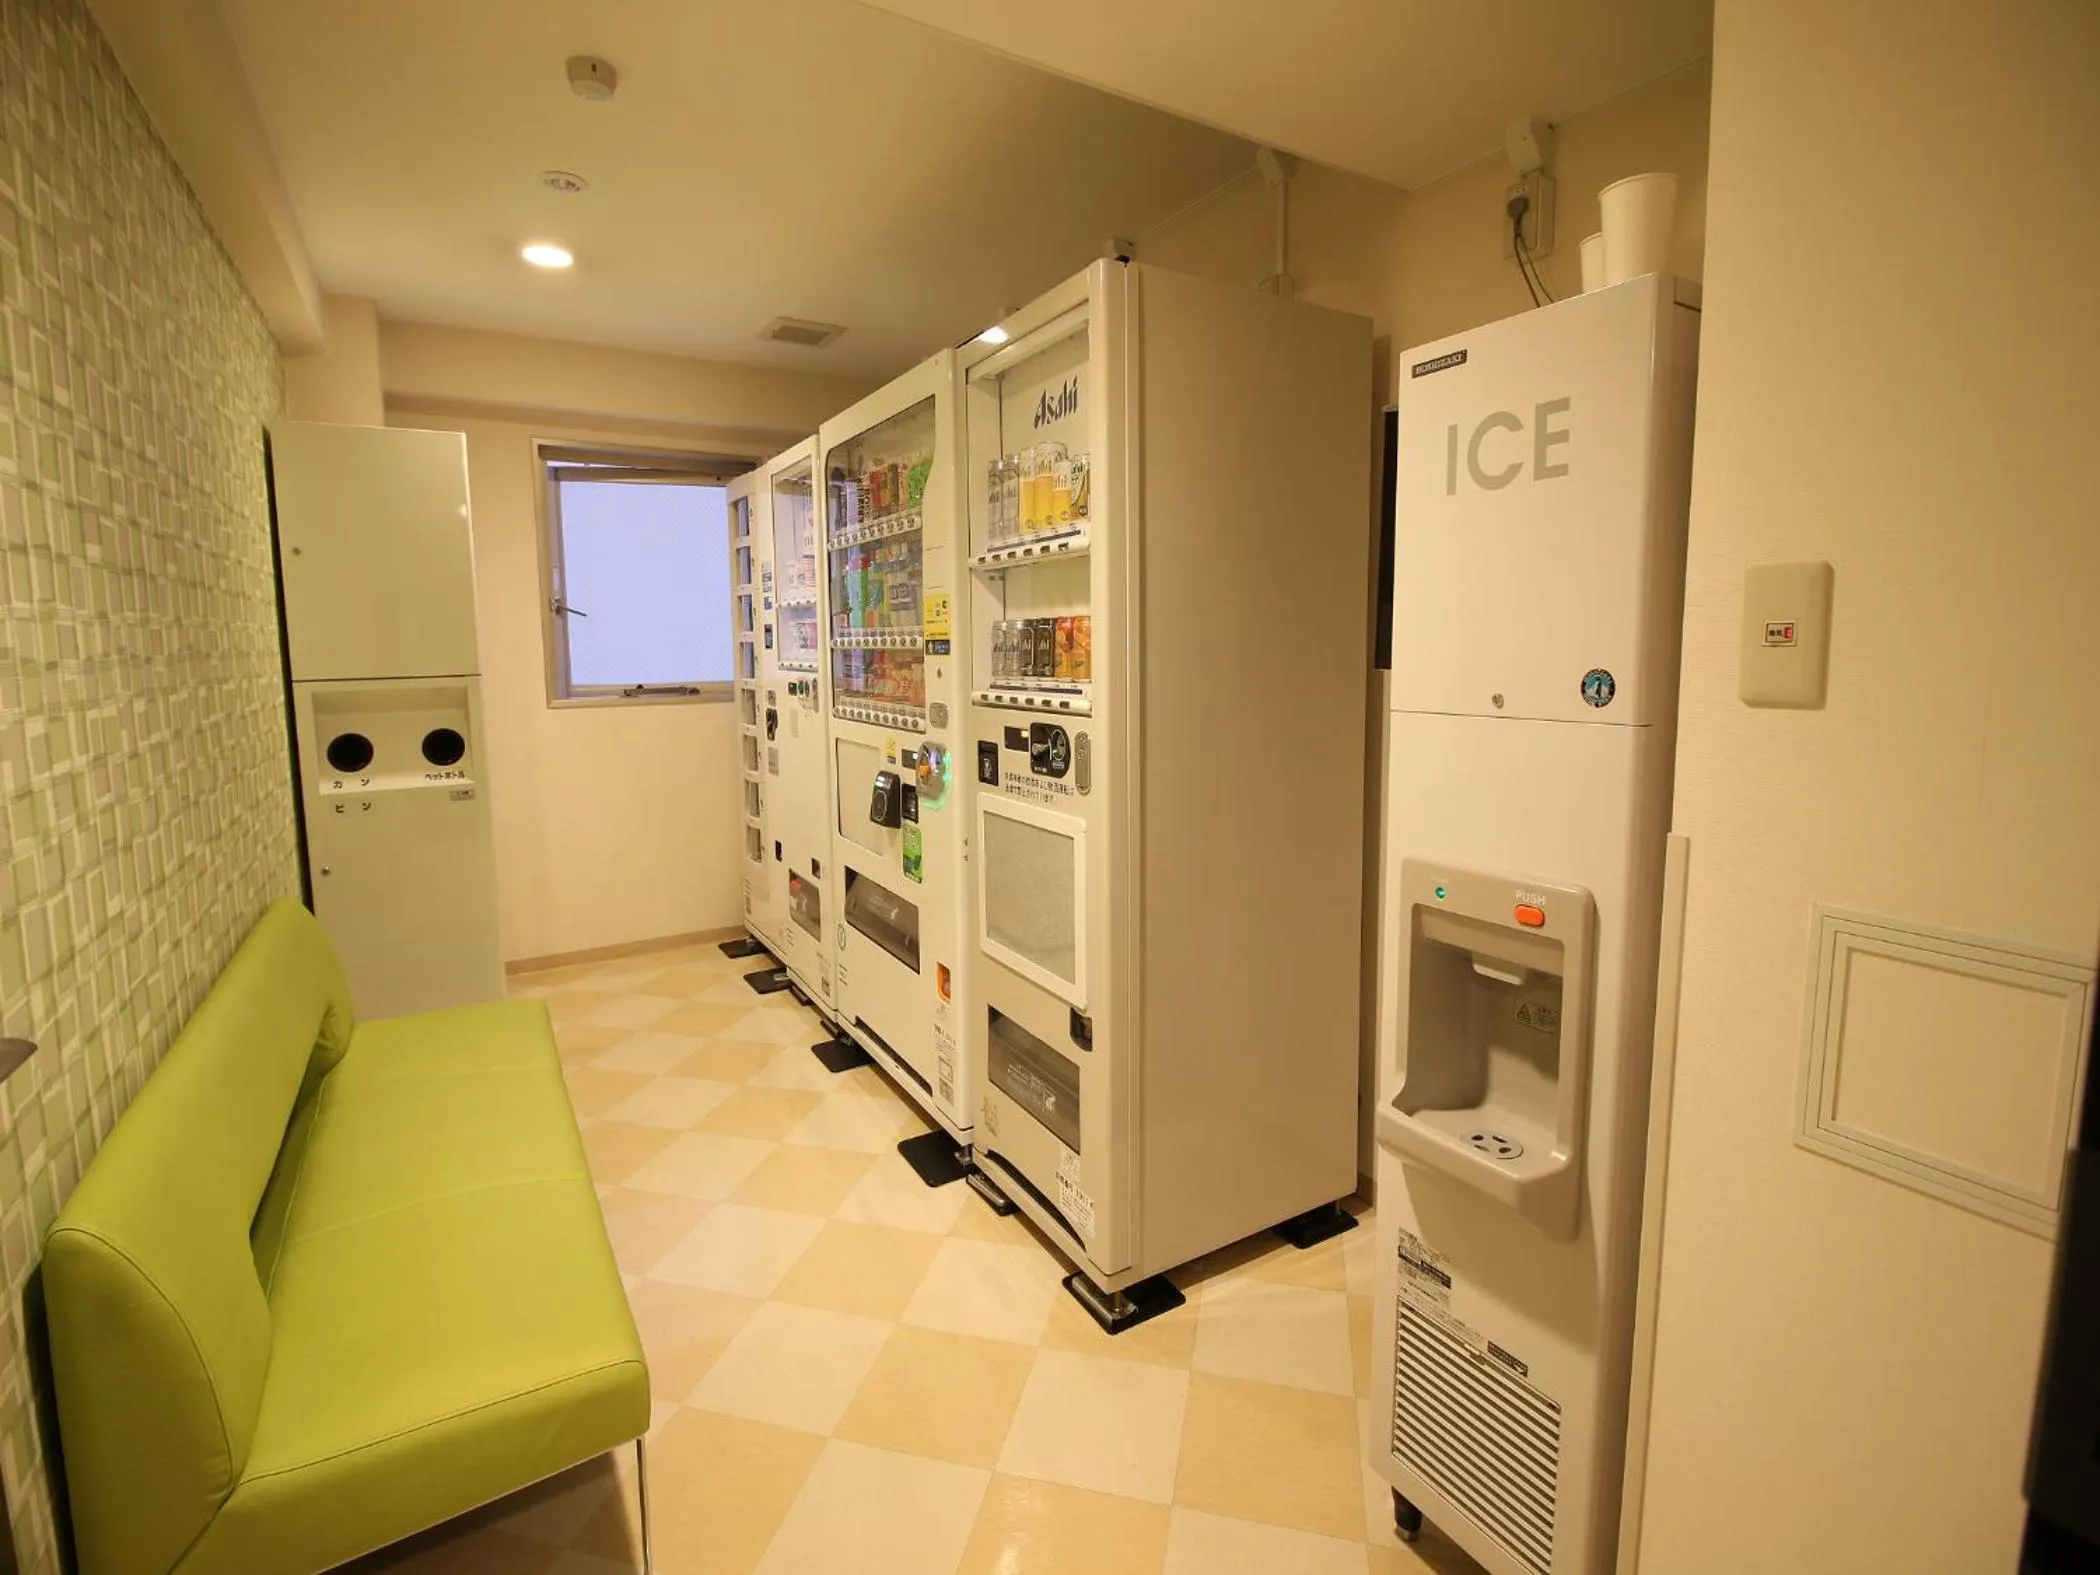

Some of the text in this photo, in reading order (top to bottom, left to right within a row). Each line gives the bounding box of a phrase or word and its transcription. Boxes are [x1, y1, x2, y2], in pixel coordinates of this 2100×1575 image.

[1034, 375, 1077, 429] Asahi
[1447, 397, 1570, 496] ICE
[1515, 890, 1546, 907] PUSH
